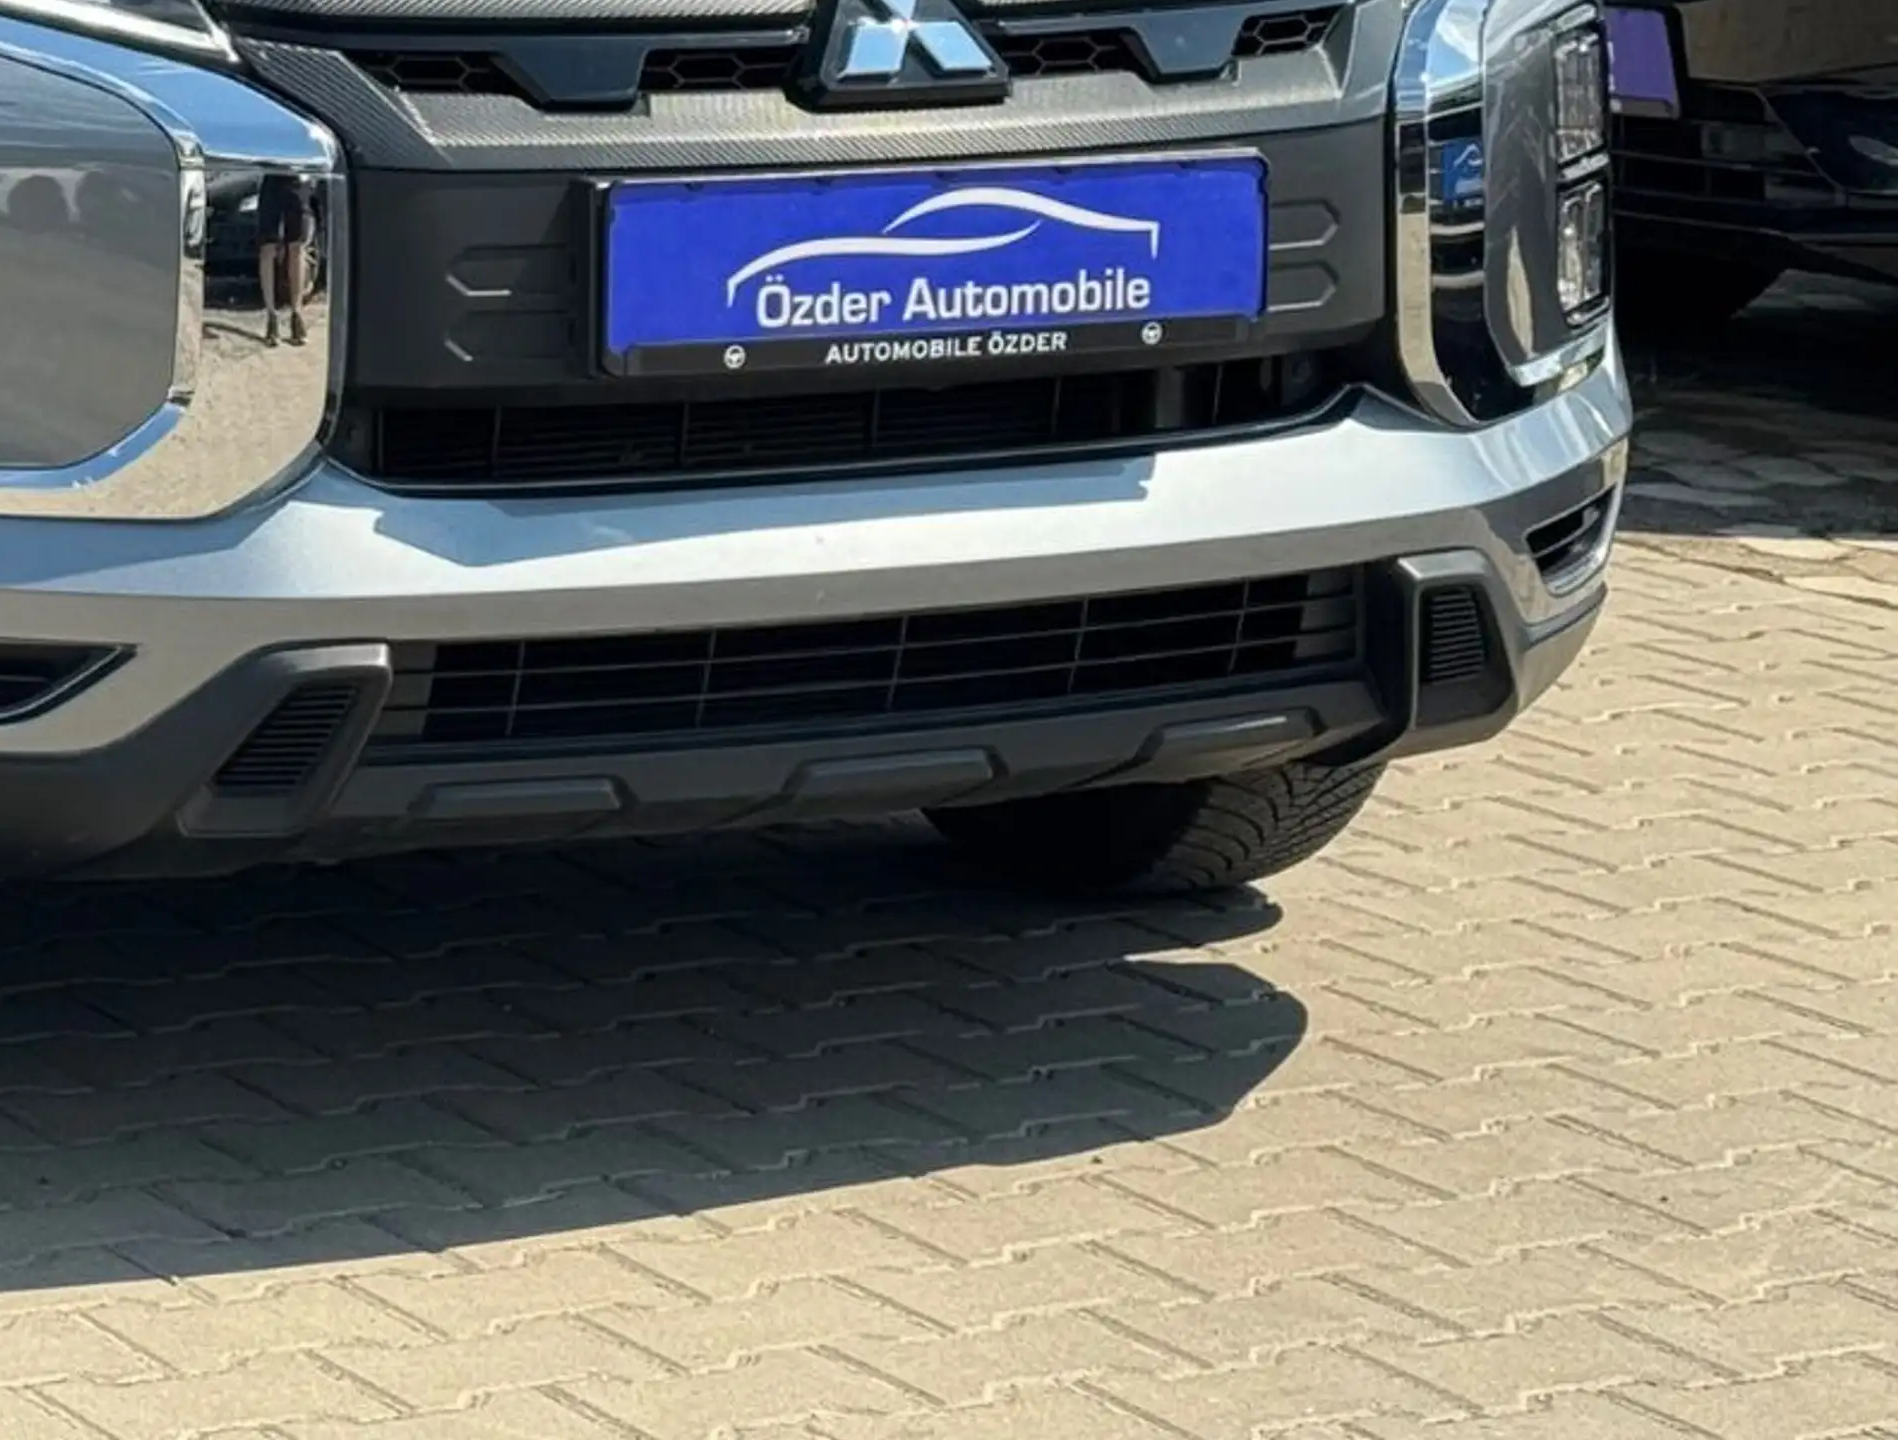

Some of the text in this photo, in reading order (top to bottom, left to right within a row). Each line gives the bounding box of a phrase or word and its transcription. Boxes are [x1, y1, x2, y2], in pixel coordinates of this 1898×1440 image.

[756, 267, 1151, 328] Özder Automobile
[825, 330, 1069, 364] AUTOMOBILE ÖZDER
